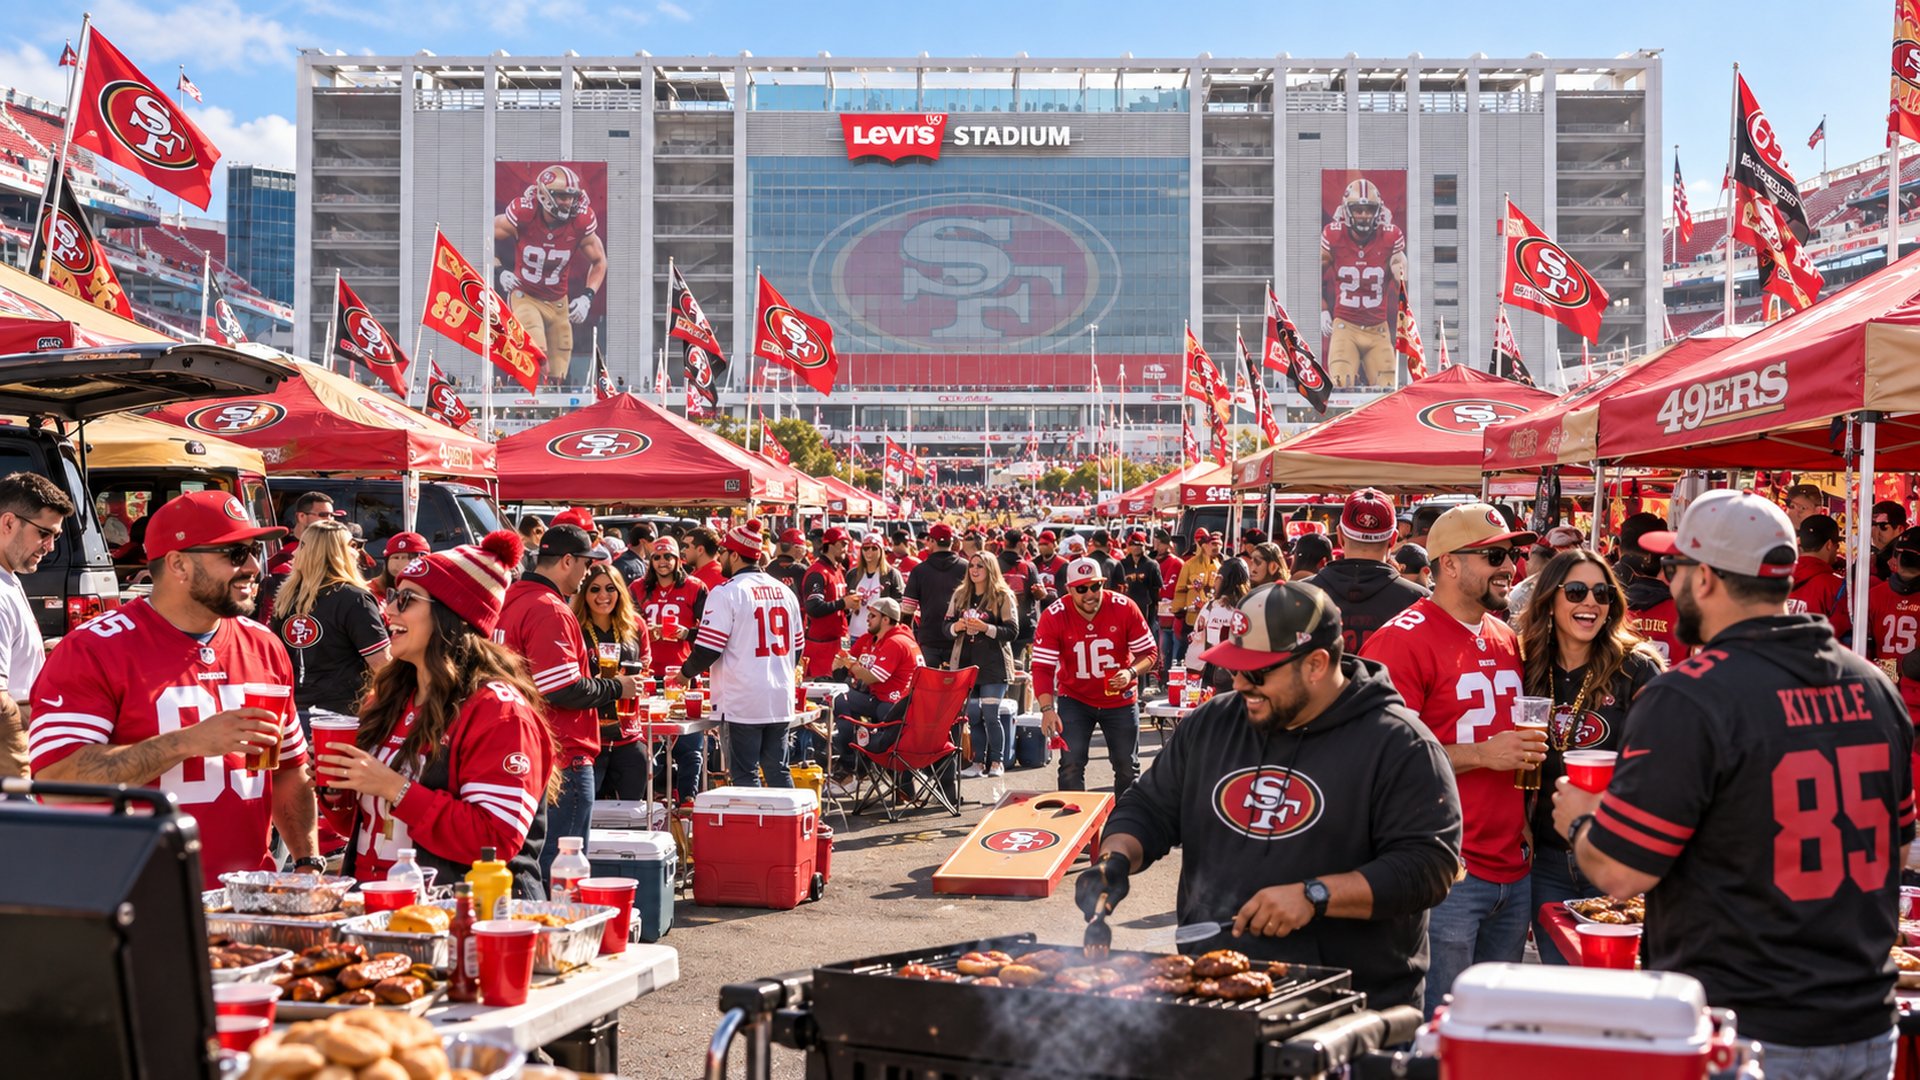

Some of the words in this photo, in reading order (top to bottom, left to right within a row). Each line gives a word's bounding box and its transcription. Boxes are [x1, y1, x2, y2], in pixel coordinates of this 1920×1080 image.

[954, 126, 1071, 146] STADIUM
[521, 245, 571, 286] 97
[1338, 266, 1385, 309] 23
[1656, 361, 1789, 434] 49ERS
[754, 606, 791, 657] 19
[1073, 638, 1115, 679] 16
[1778, 683, 1873, 728] KITTLE
[1772, 743, 1892, 902] 85
